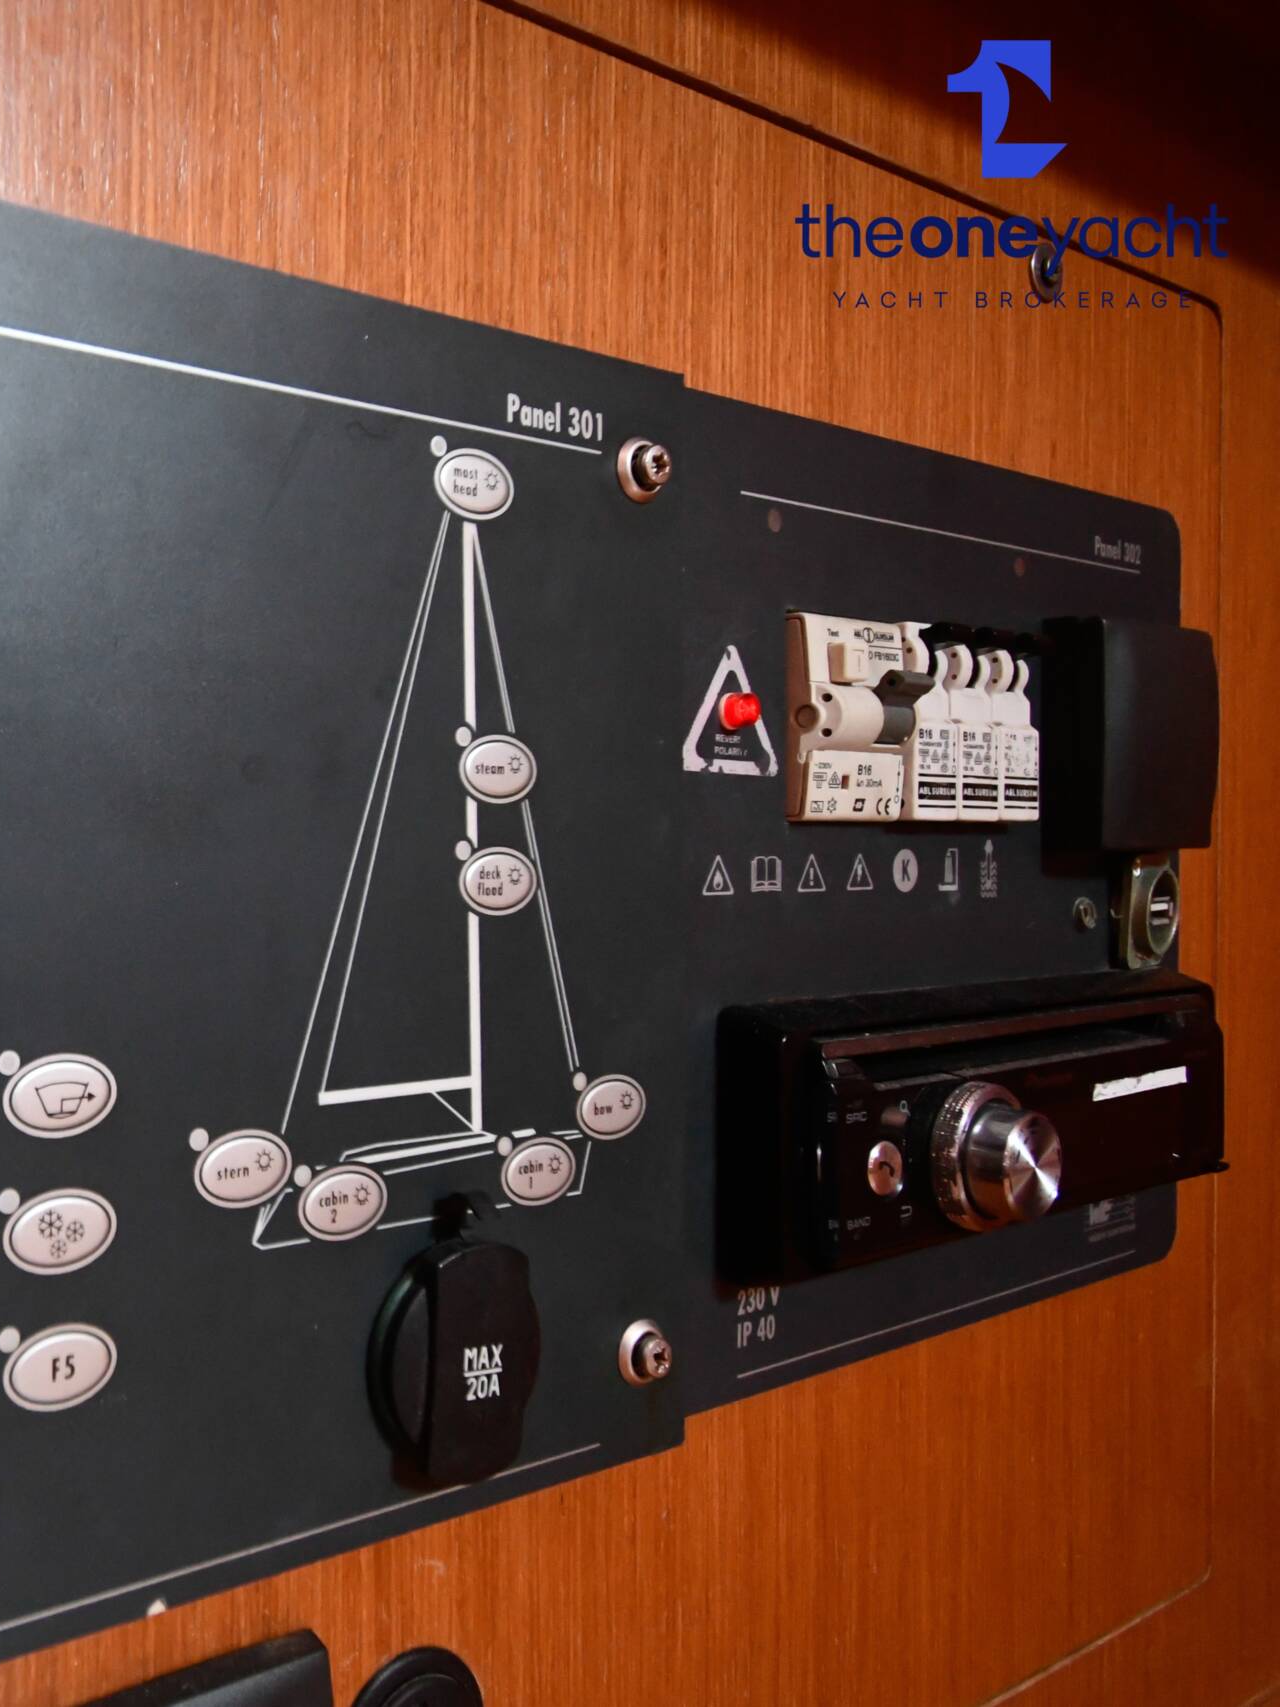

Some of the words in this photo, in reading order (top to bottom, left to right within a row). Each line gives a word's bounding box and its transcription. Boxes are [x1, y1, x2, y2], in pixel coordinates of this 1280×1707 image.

[507, 392, 561, 433] Panel
[568, 406, 603, 442] 301
[453, 467, 478, 480] mast
[453, 478, 478, 497] head
[1094, 535, 1122, 560] Panel
[475, 763, 505, 775] steam
[857, 764, 873, 776] B16
[479, 865, 502, 880] deck
[902, 859, 911, 882] K
[477, 882, 504, 896] flood
[594, 1103, 613, 1116] bow
[845, 1111, 869, 1125] SRC
[217, 1165, 250, 1181] stern
[518, 1159, 544, 1175] cabin
[528, 1176, 534, 1190] 1
[319, 1189, 350, 1208] cabin
[330, 1208, 339, 1224] 2
[846, 1216, 872, 1230] BAND
[736, 1287, 766, 1316] 230
[770, 1286, 780, 1307] V
[736, 1321, 753, 1349] IP
[757, 1314, 776, 1342] 40
[463, 1343, 503, 1372] MAX
[51, 1353, 76, 1383] F5
[466, 1373, 501, 1401] 20A
